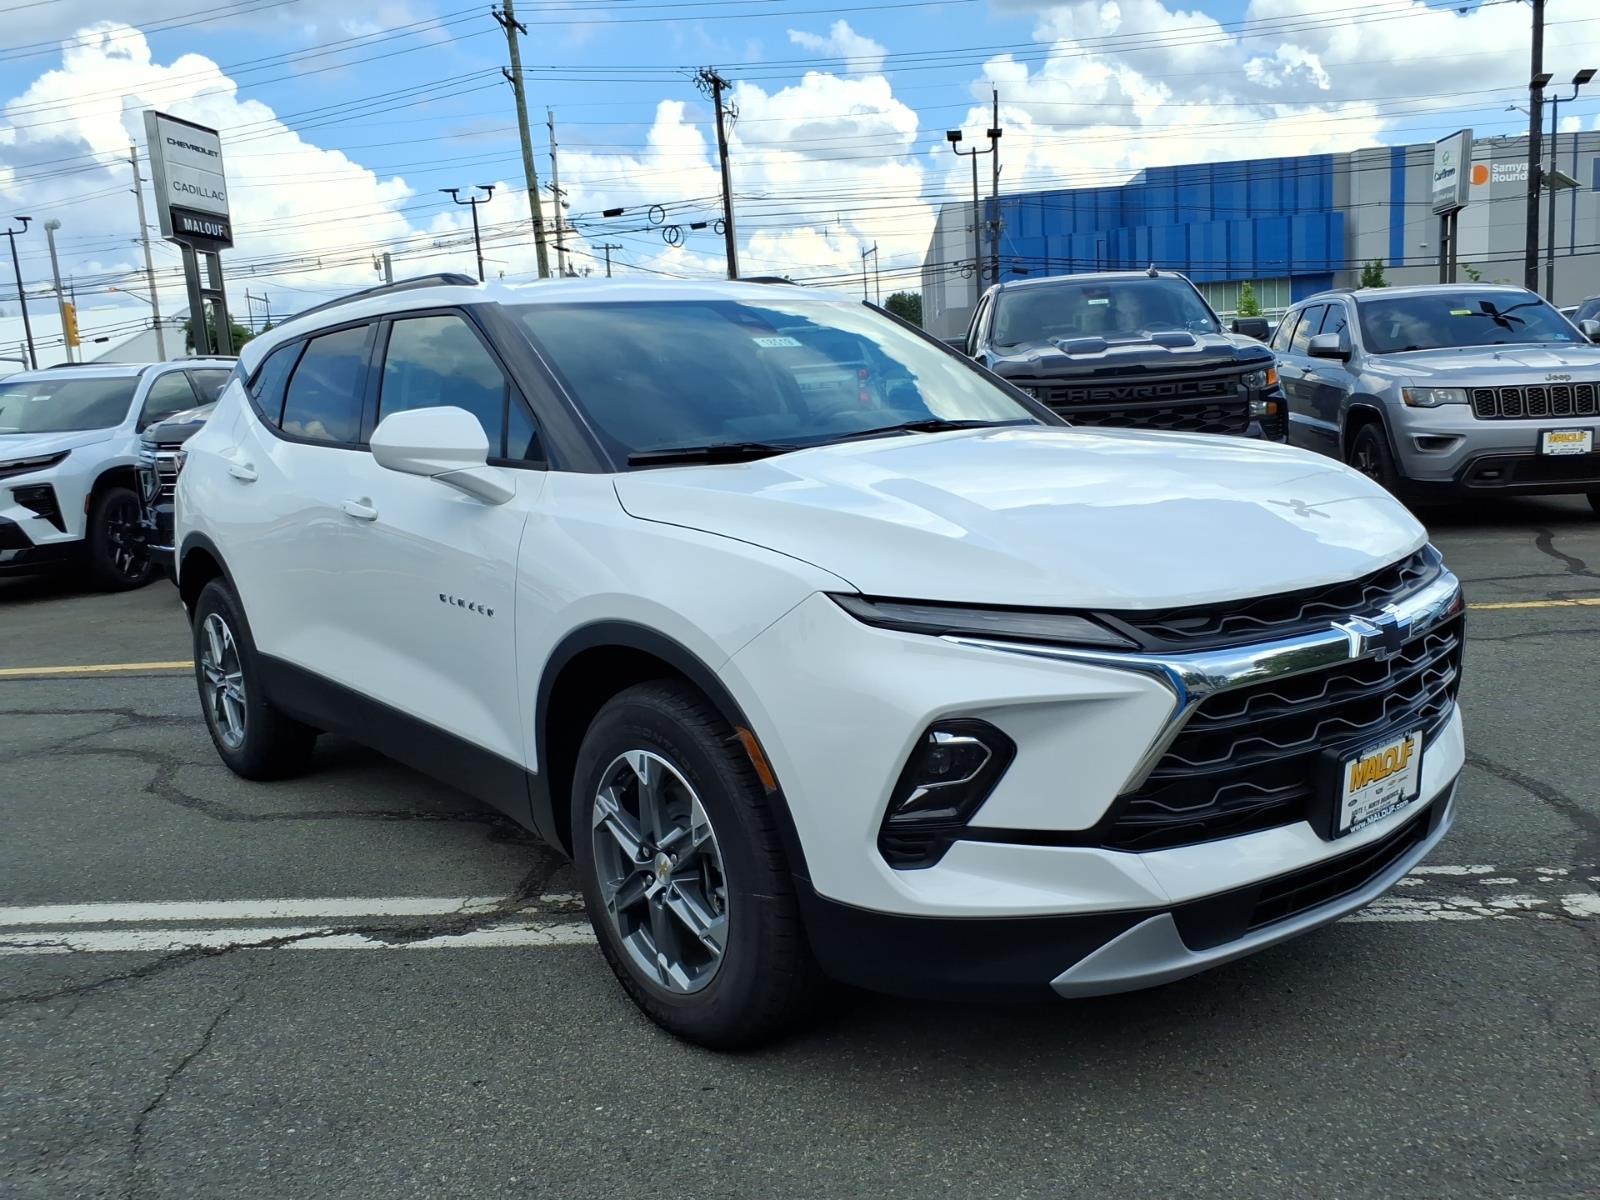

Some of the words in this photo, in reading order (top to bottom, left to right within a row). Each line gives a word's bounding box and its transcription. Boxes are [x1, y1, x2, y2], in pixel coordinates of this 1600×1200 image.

[166, 137, 219, 158] CHEVROLET
[1492, 162, 1529, 173] Samya
[173, 181, 225, 201] CADILLAC
[183, 218, 224, 237] MALOUF
[1545, 373, 1571, 382] Jeep
[1048, 378, 1237, 402] CHEVROLET
[439, 593, 495, 617] BLAZER
[1349, 738, 1415, 793] MALOUF
